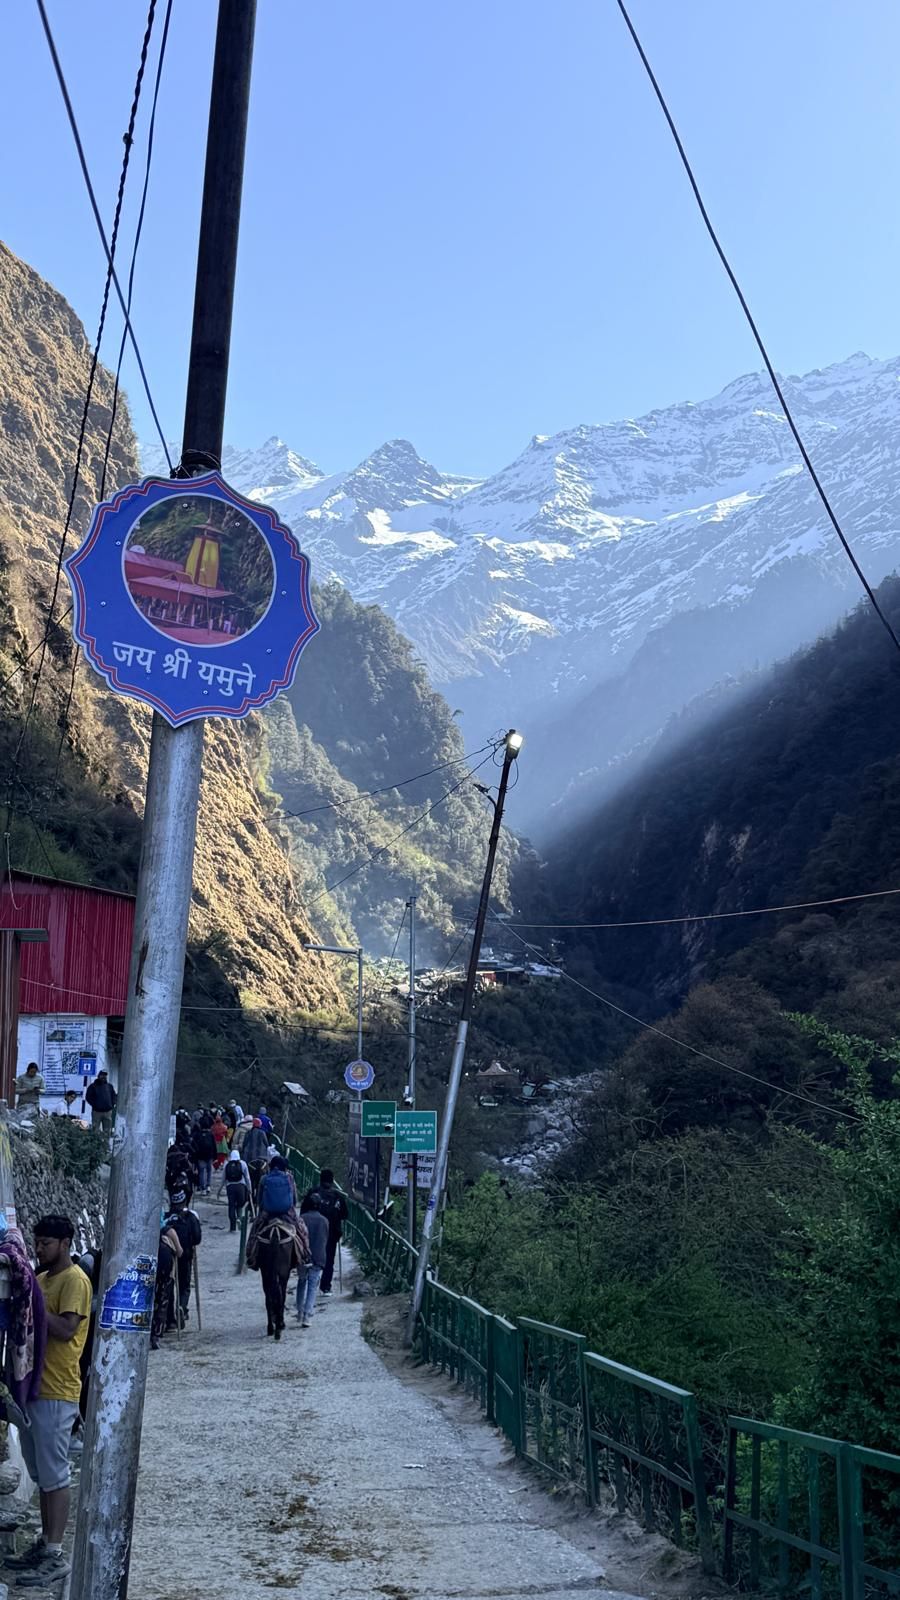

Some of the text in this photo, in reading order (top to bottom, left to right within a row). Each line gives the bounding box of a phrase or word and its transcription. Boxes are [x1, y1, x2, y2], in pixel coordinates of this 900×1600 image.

[112, 641, 256, 697] जय श्री यमुने
